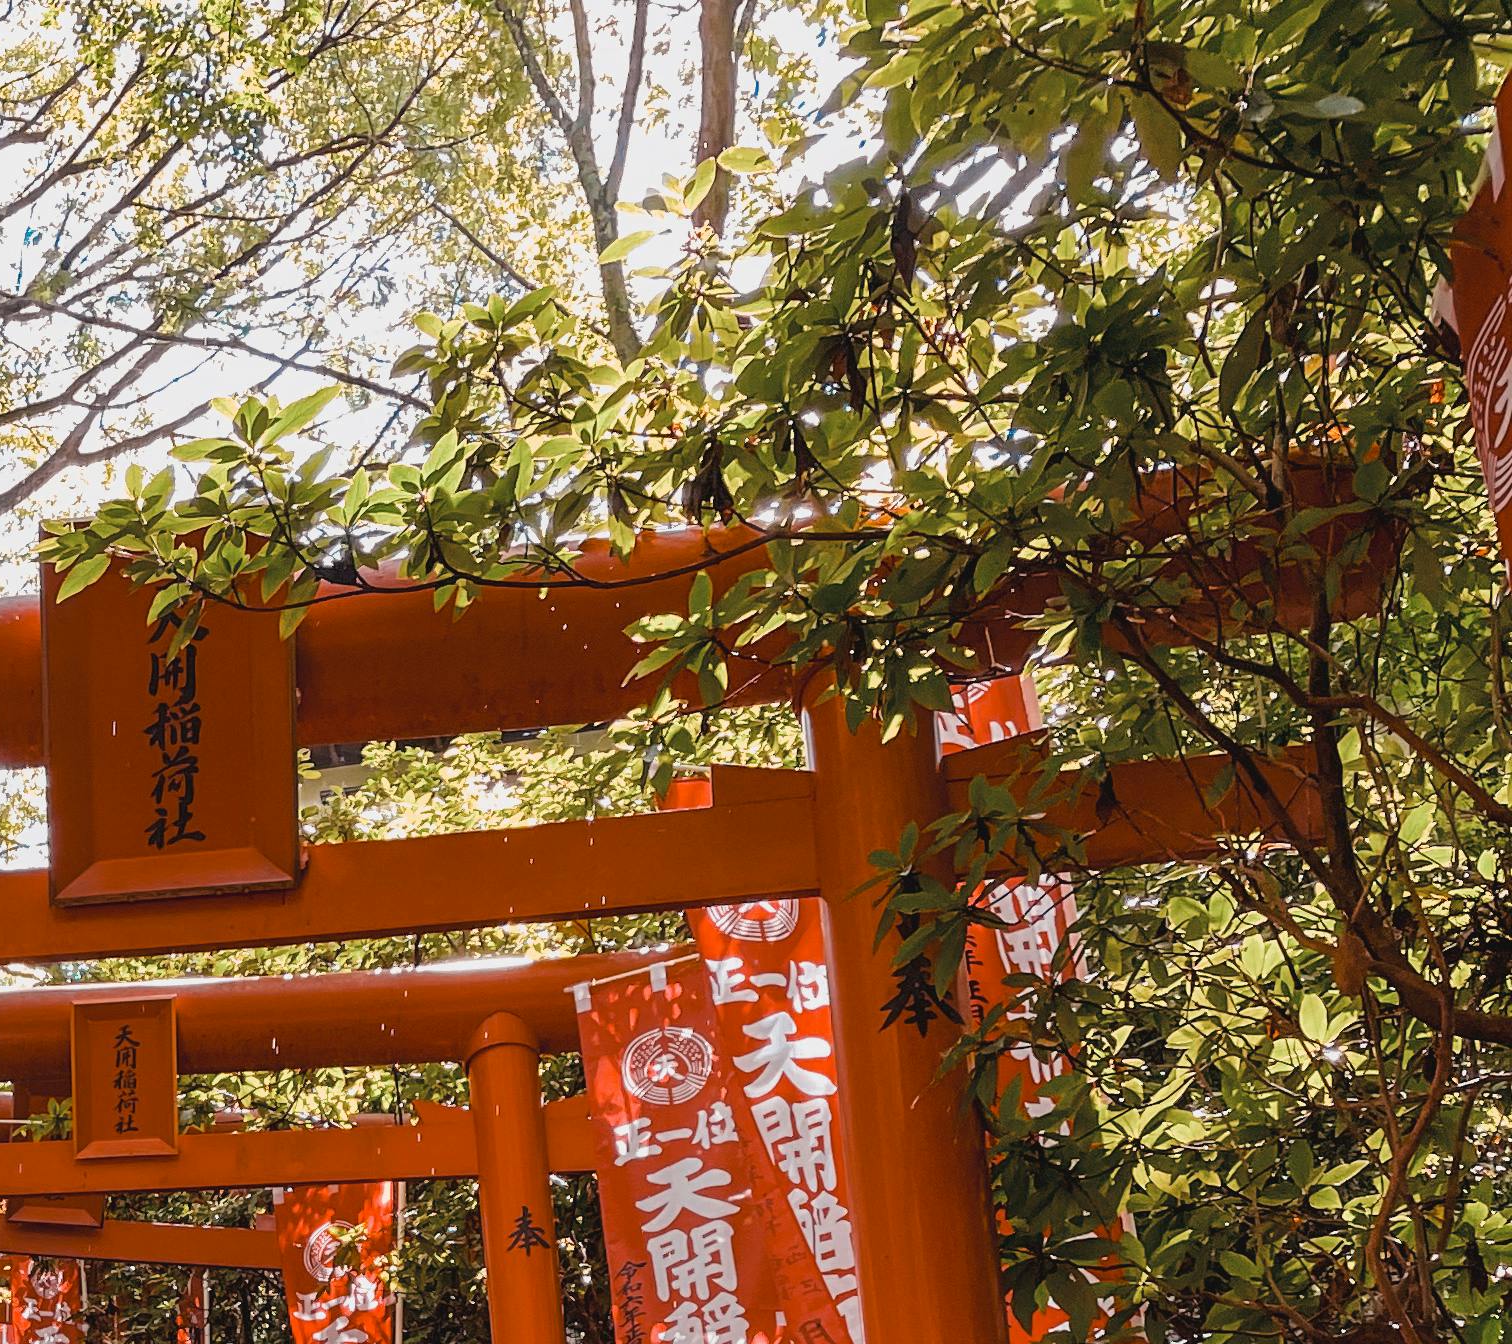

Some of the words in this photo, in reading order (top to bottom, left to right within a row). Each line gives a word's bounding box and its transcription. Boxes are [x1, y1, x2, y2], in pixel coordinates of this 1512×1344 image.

[705, 959, 830, 1016] 正一位
[878, 952, 966, 1039] 奉
[111, 1024, 142, 1135] 天開稲荷社
[612, 1100, 740, 1167] 正一位
[506, 1206, 552, 1257] 奉
